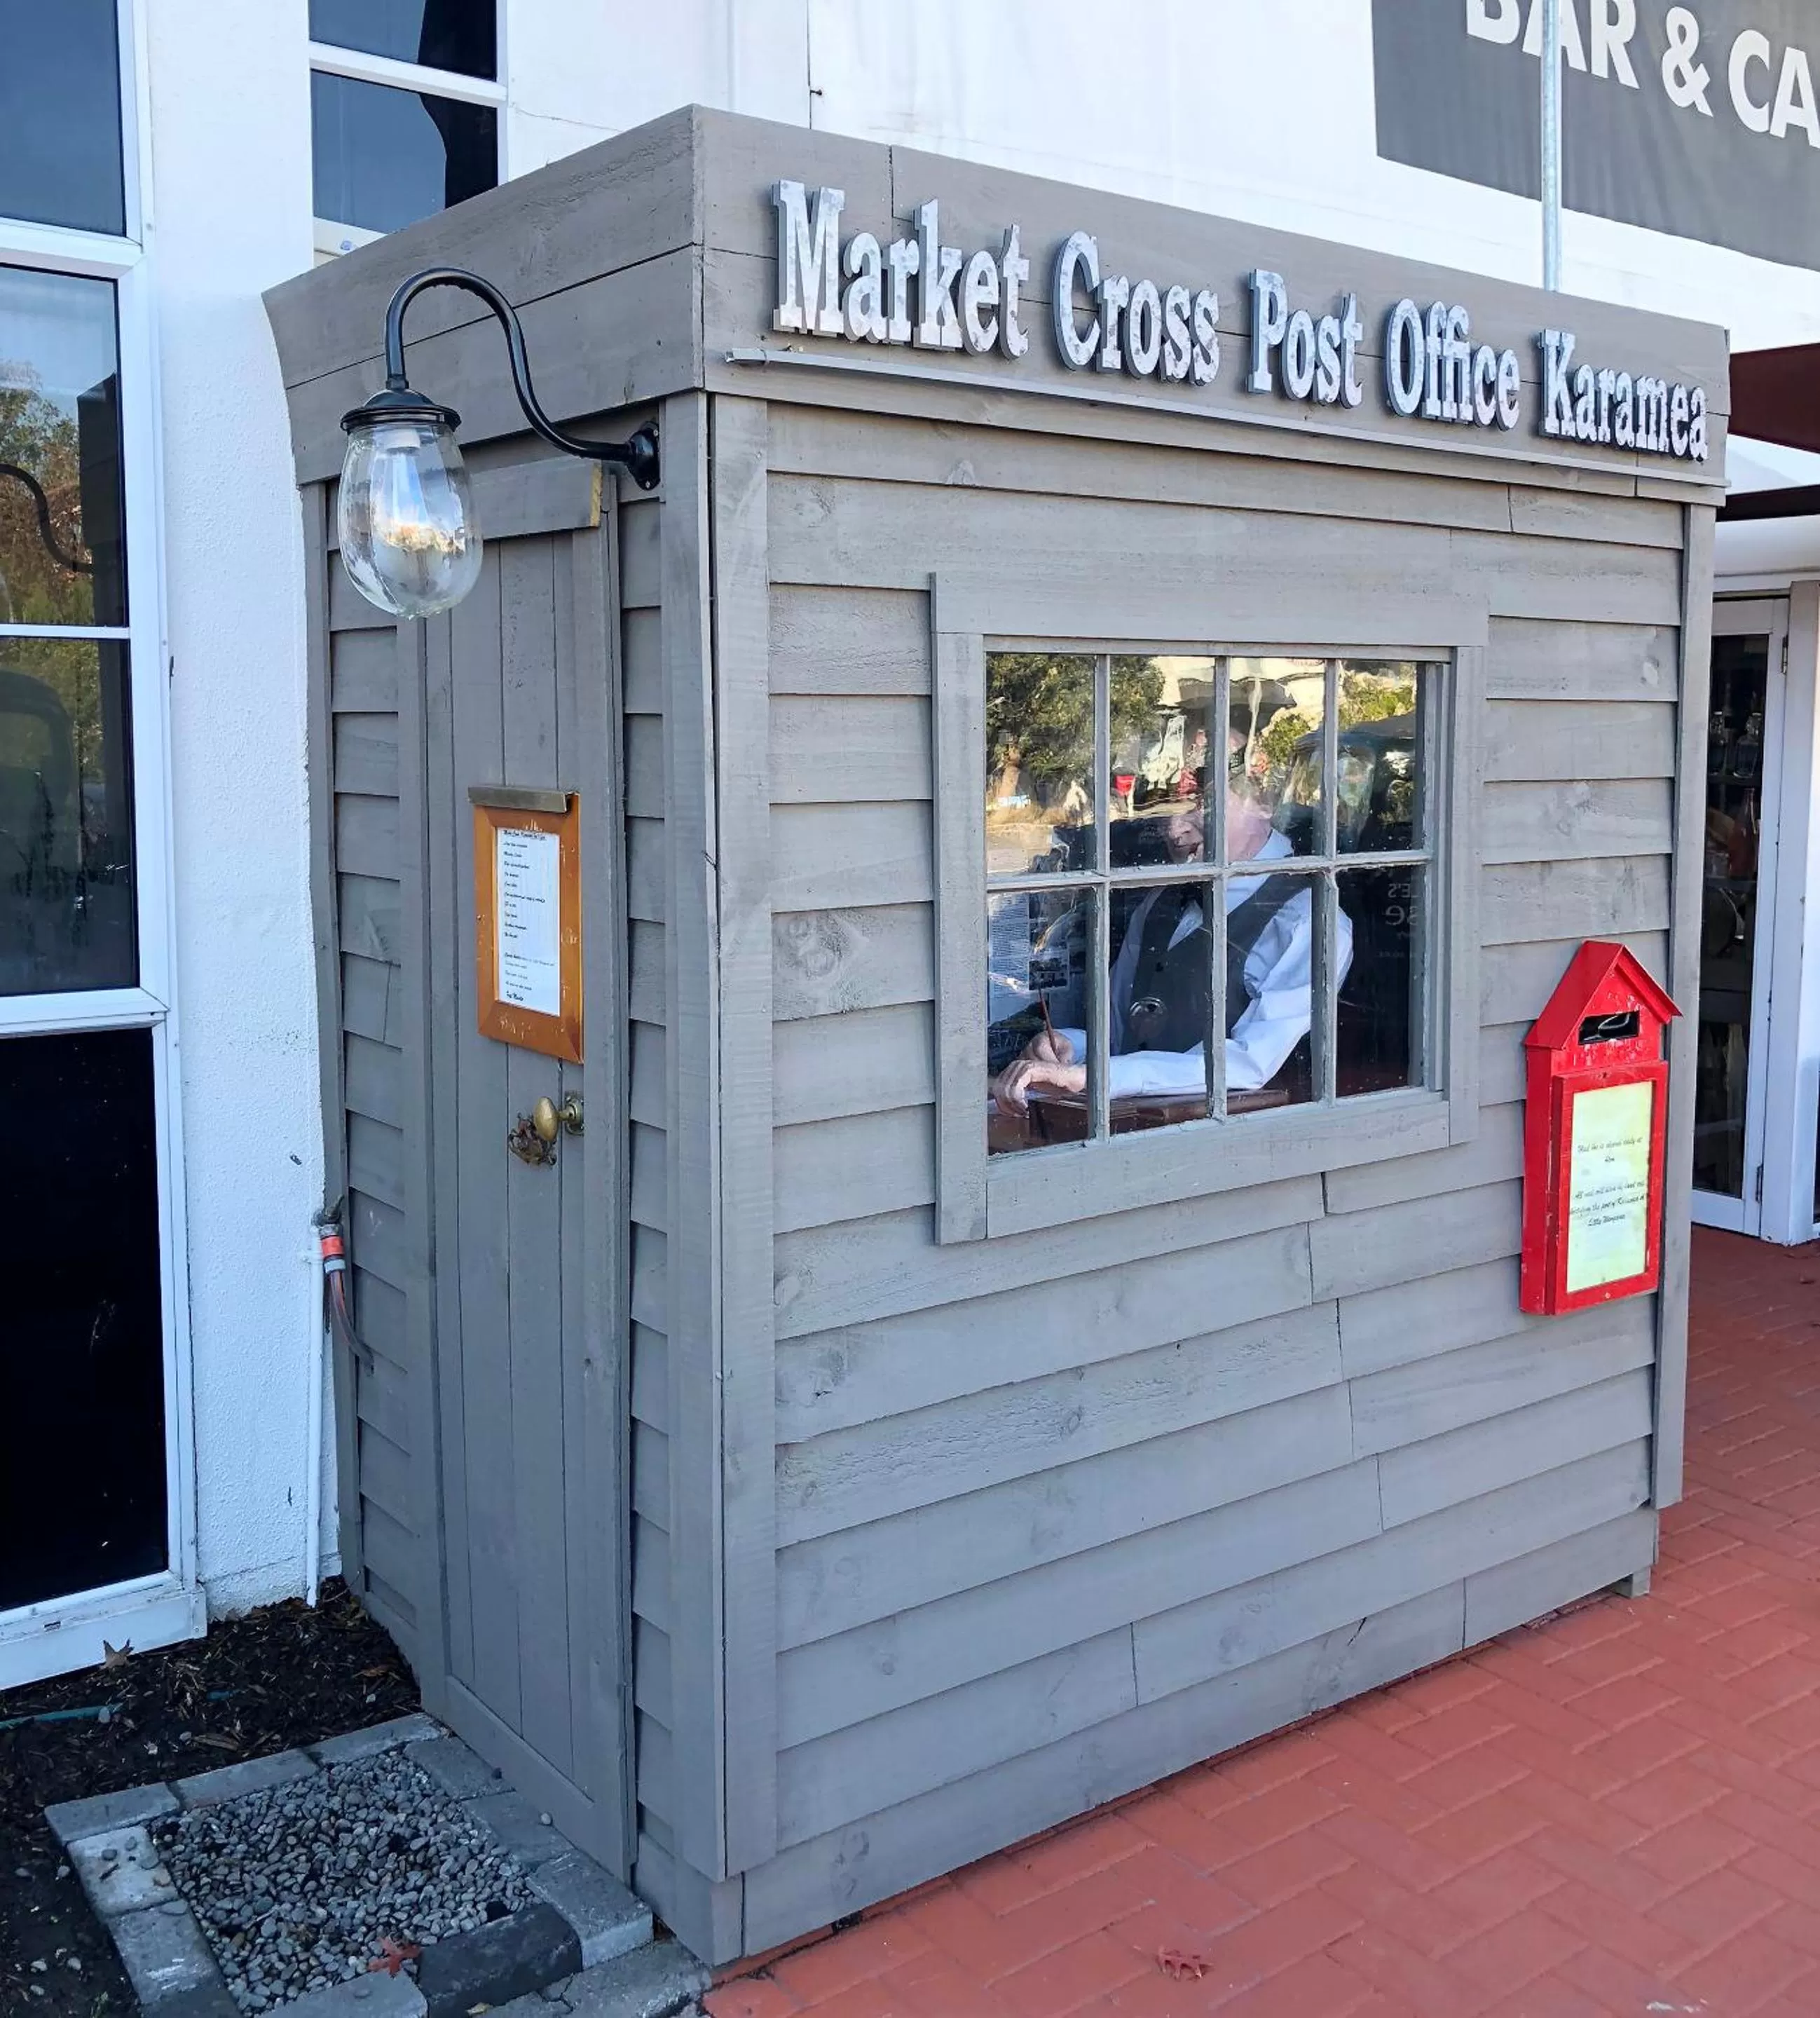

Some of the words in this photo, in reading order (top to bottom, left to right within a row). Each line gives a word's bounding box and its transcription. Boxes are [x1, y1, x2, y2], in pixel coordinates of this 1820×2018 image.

[1662, 6, 1713, 117] &
[1728, 29, 1820, 149] CA
[771, 179, 1030, 360] Market
[1051, 231, 1220, 386] Cross
[1247, 268, 1364, 409] Post
[1385, 298, 1520, 431] Office
[1538, 329, 1709, 462] Karamea
